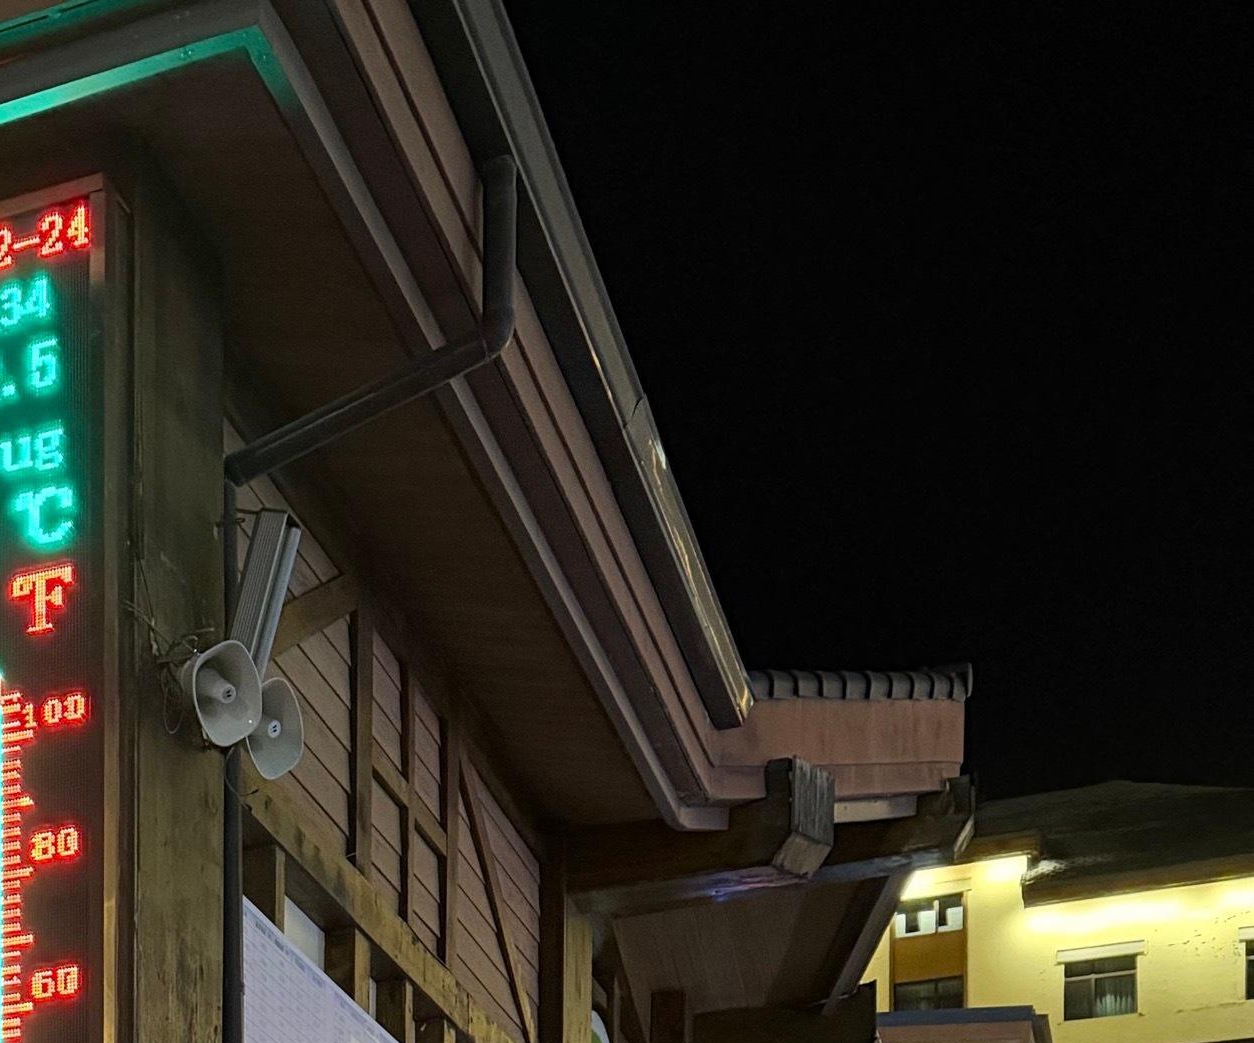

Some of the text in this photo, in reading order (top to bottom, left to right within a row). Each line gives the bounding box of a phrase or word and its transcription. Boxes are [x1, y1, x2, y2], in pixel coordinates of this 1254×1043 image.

[22, 693, 86, 728] 100
[30, 826, 80, 861] 80
[30, 965, 80, 1000] 60
